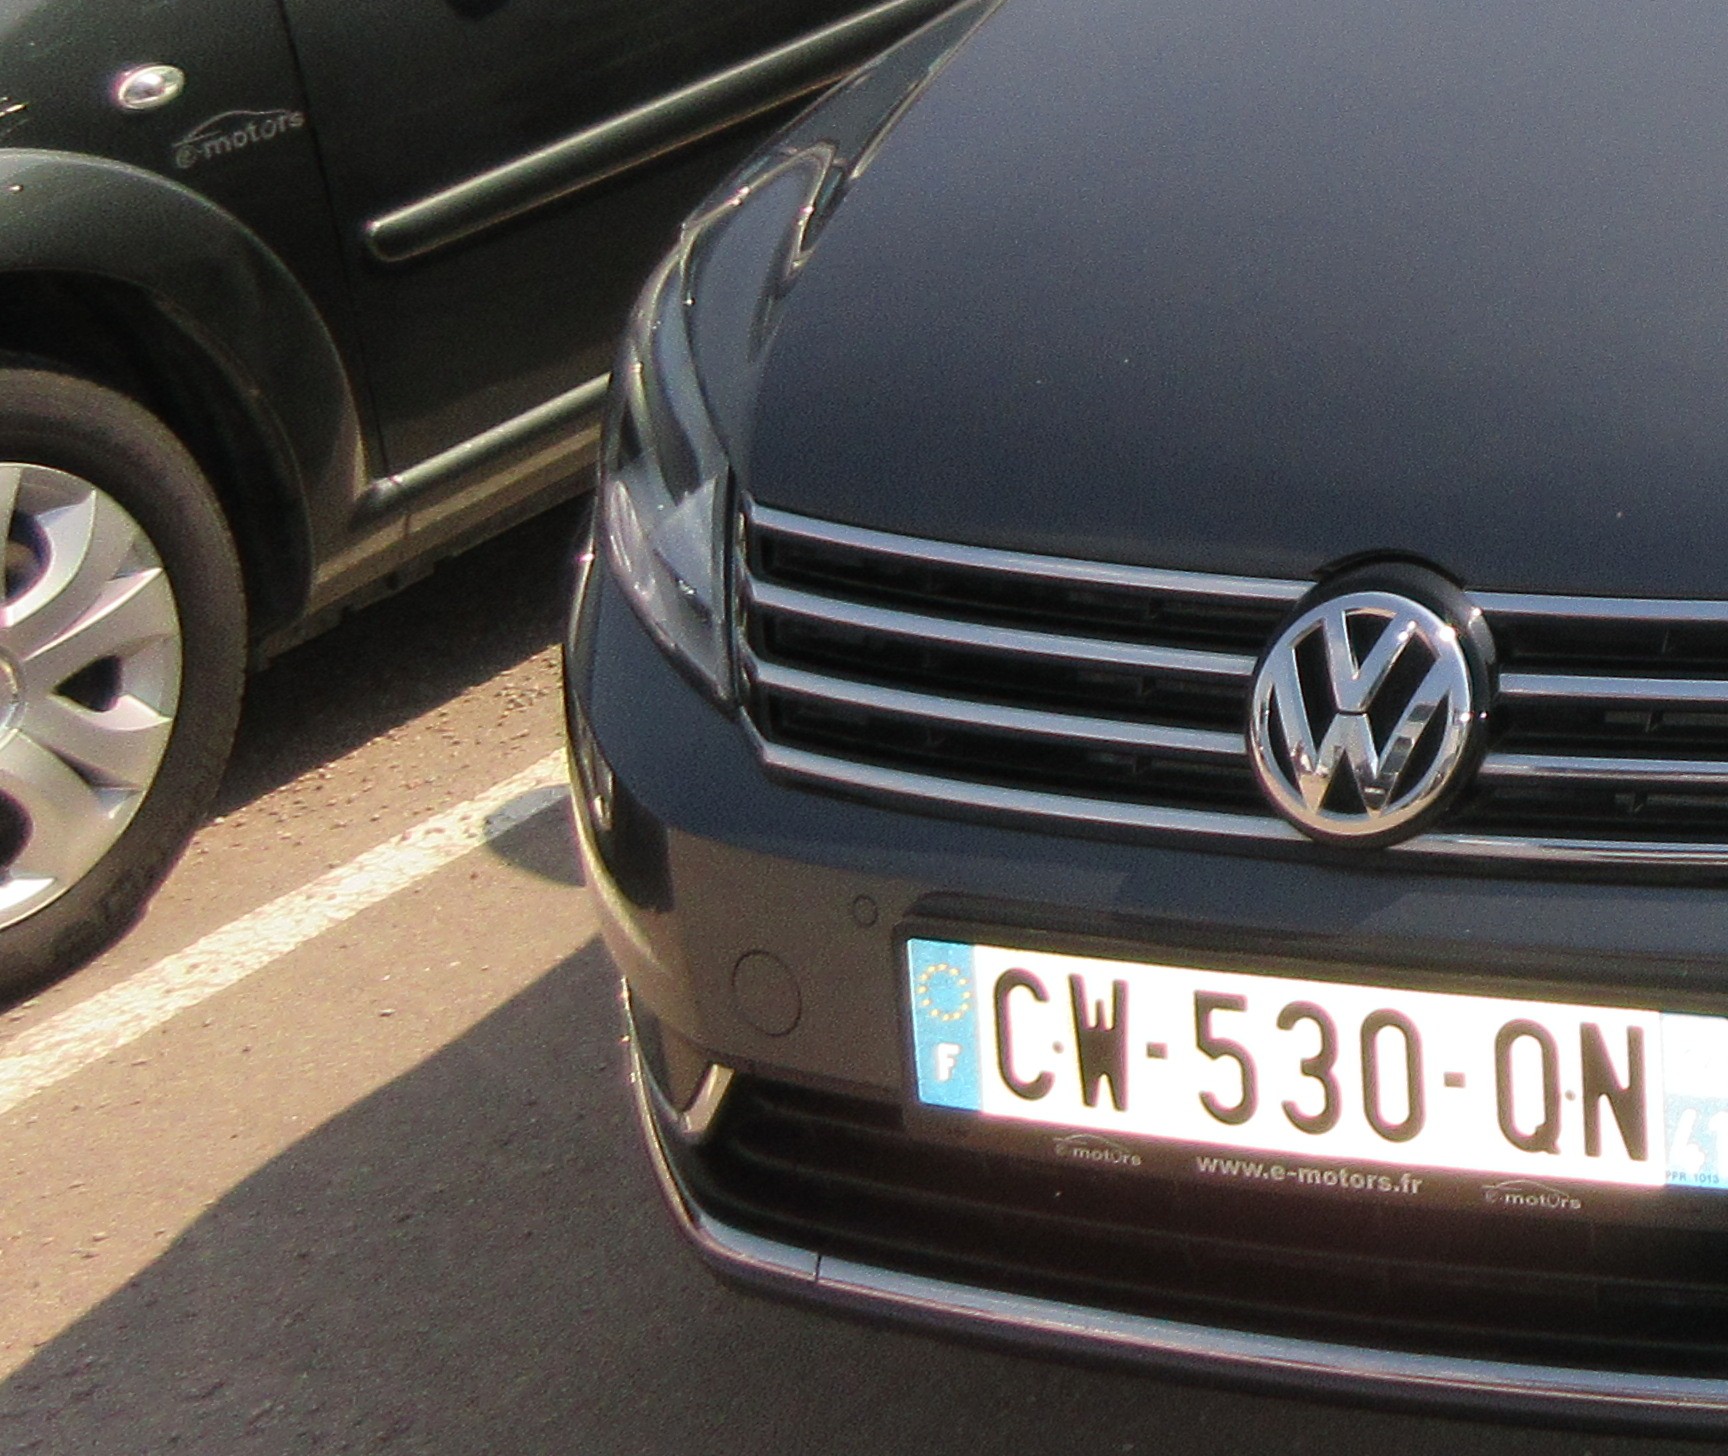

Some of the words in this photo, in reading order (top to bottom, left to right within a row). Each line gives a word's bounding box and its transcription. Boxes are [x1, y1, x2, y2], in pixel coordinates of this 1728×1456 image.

[176, 111, 304, 169] e-motors
[1256, 596, 1468, 831] VW
[935, 1043, 962, 1082] F
[1196, 1155, 1424, 1194] www.e-motors.fr
